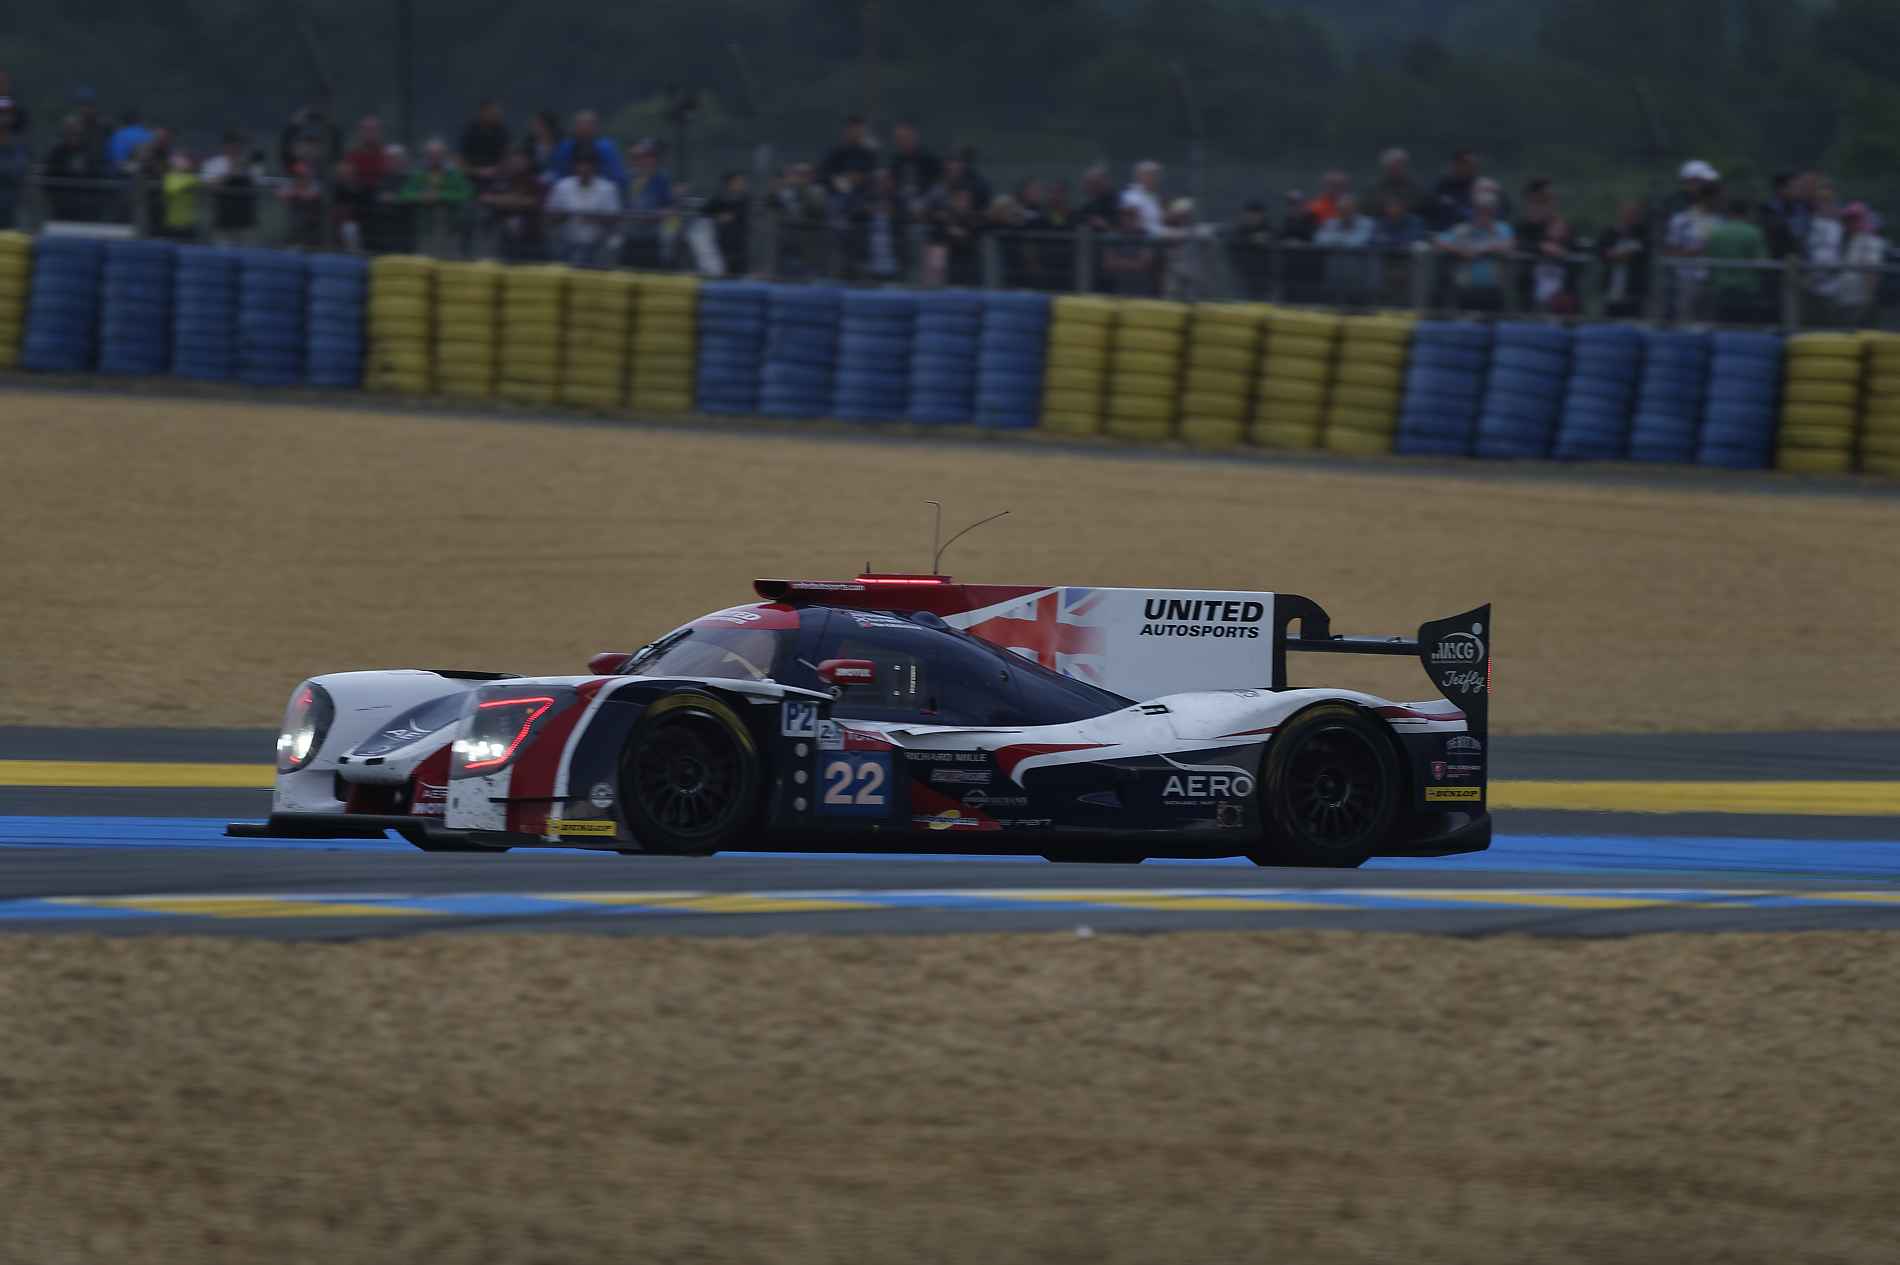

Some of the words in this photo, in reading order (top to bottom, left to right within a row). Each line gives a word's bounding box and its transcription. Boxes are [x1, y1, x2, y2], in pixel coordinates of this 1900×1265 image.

[1144, 598, 1264, 622] UNITED
[1139, 624, 1260, 638] AUTOSPORTS
[787, 703, 813, 731] P2
[903, 751, 953, 762] RICHARD
[955, 752, 988, 762] MILLE
[823, 761, 885, 805] 22
[1160, 775, 1254, 798] AERO
